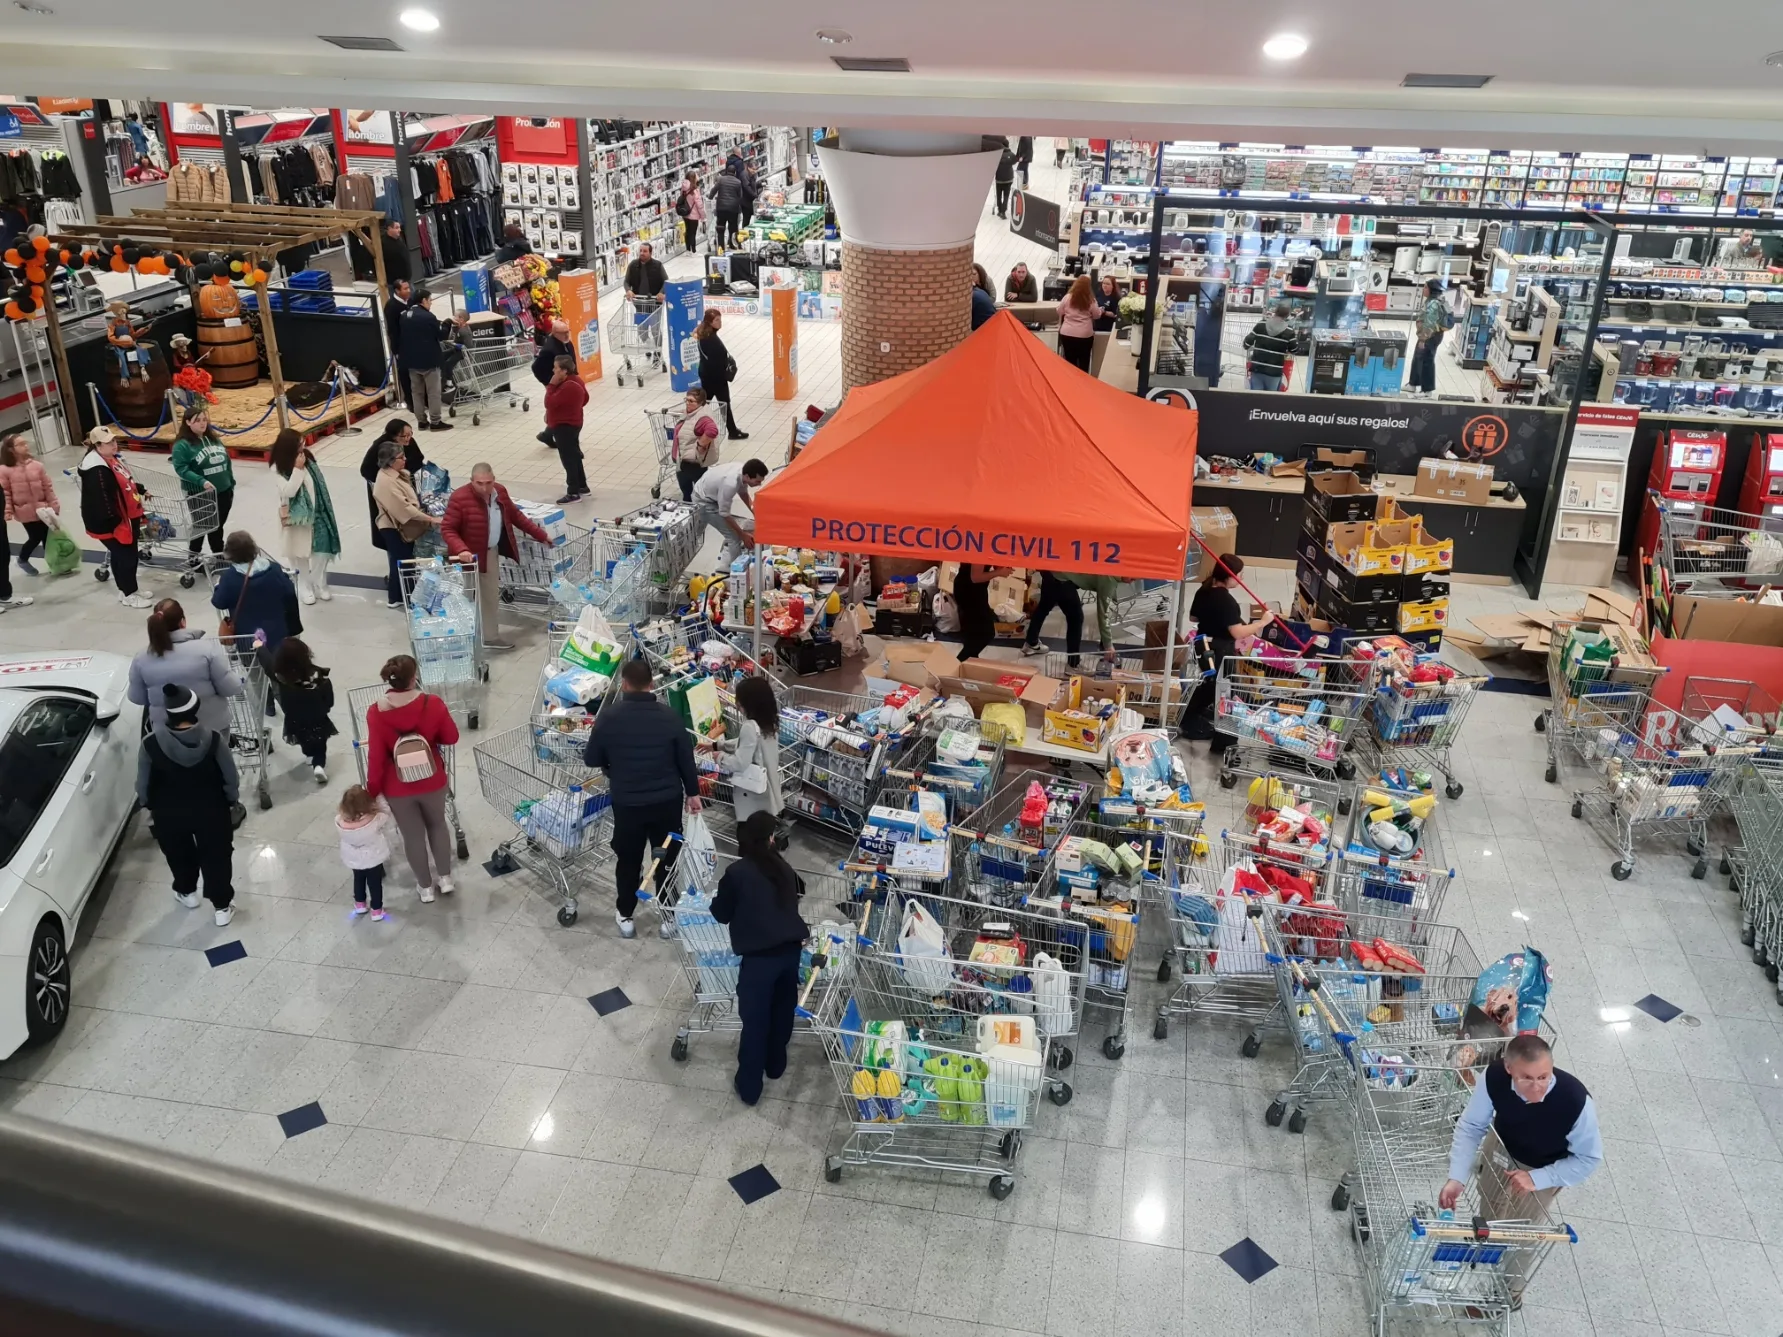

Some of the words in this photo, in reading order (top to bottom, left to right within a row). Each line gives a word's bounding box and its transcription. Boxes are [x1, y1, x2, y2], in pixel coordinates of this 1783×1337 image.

[515, 117, 561, 129] Proión
[348, 130, 385, 141] hombre
[1249, 409, 1306, 423] ¡Envuelva
[1307, 413, 1336, 426] aquí
[1336, 417, 1358, 426] sus
[1359, 417, 1409, 430] regalos!
[811, 517, 984, 554] PROTECCIÓN
[991, 533, 1061, 561] CIVIL
[1070, 540, 1121, 564] 112
